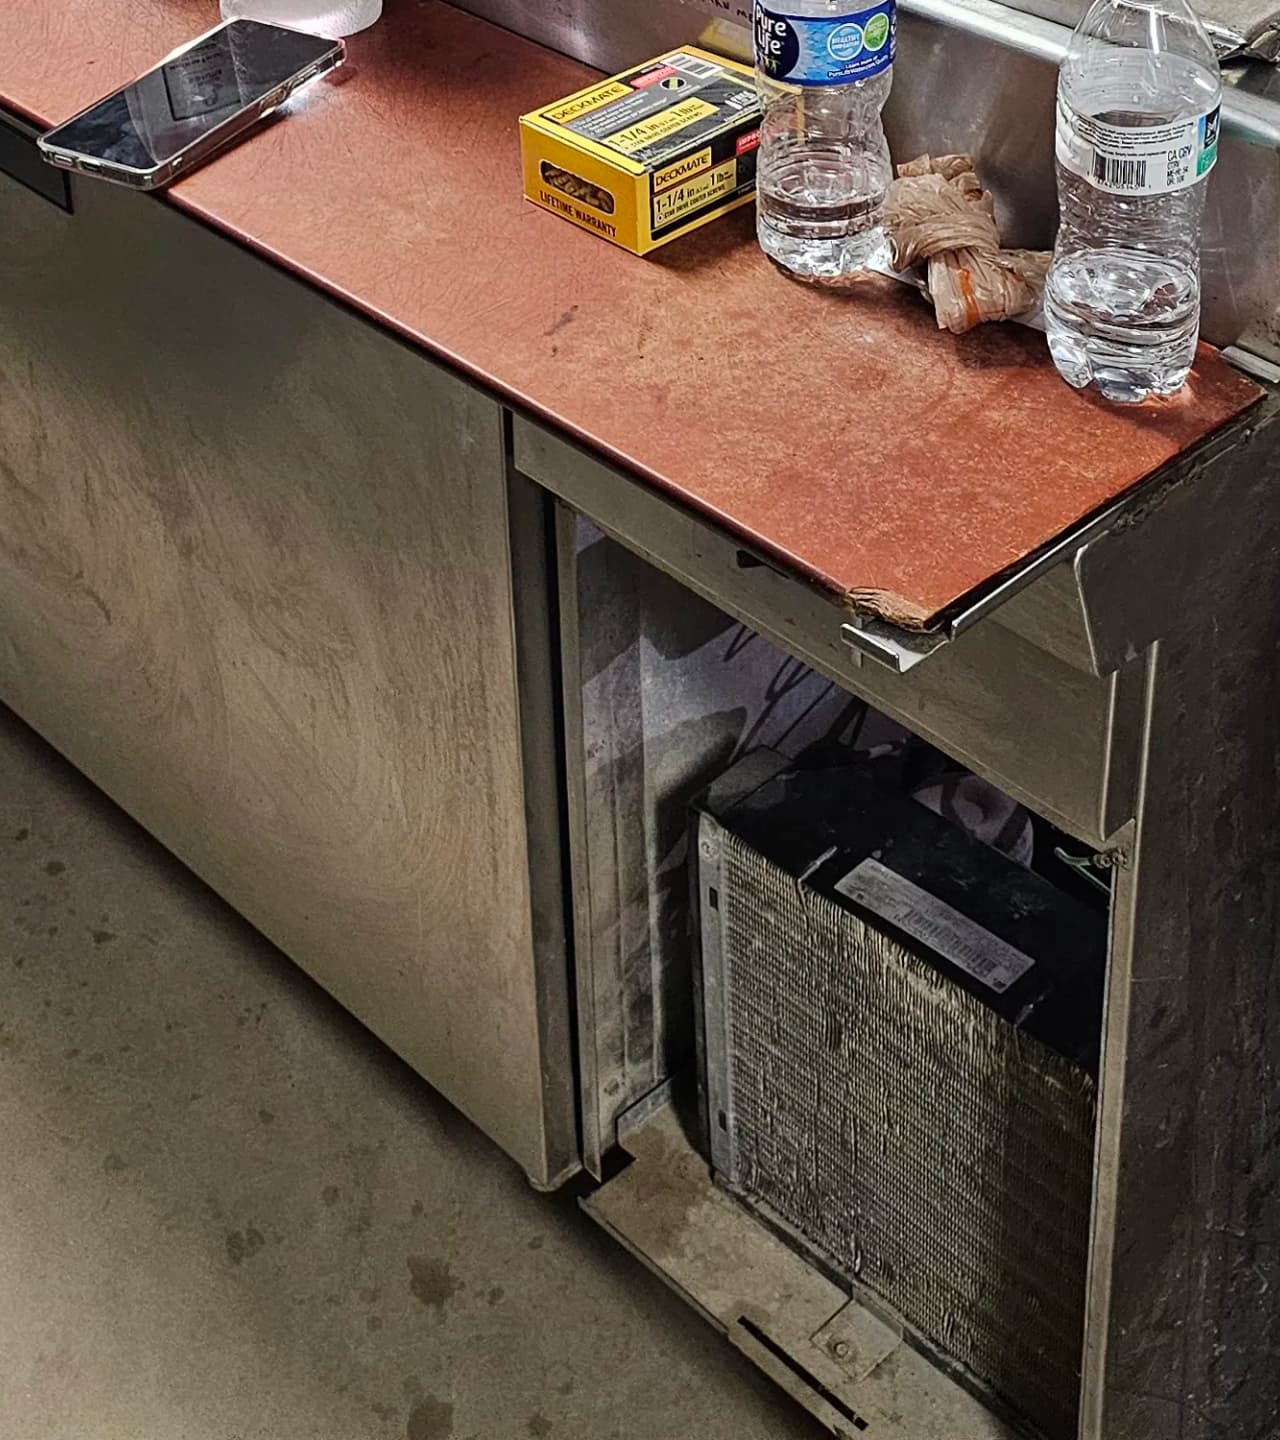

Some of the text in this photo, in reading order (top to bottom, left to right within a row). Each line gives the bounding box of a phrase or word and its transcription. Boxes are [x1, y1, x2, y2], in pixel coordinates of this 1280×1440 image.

[754, 4, 786, 36] Pure
[756, 27, 781, 54] Life
[552, 84, 624, 120] DECKMATE
[608, 124, 647, 150] 1-1/4
[655, 155, 709, 185] DECKMATE
[1168, 150, 1178, 162] CA
[656, 186, 685, 213] 1-1/4
[710, 172, 716, 185] 1
[540, 190, 617, 237] LIFETIME WARRANTY
